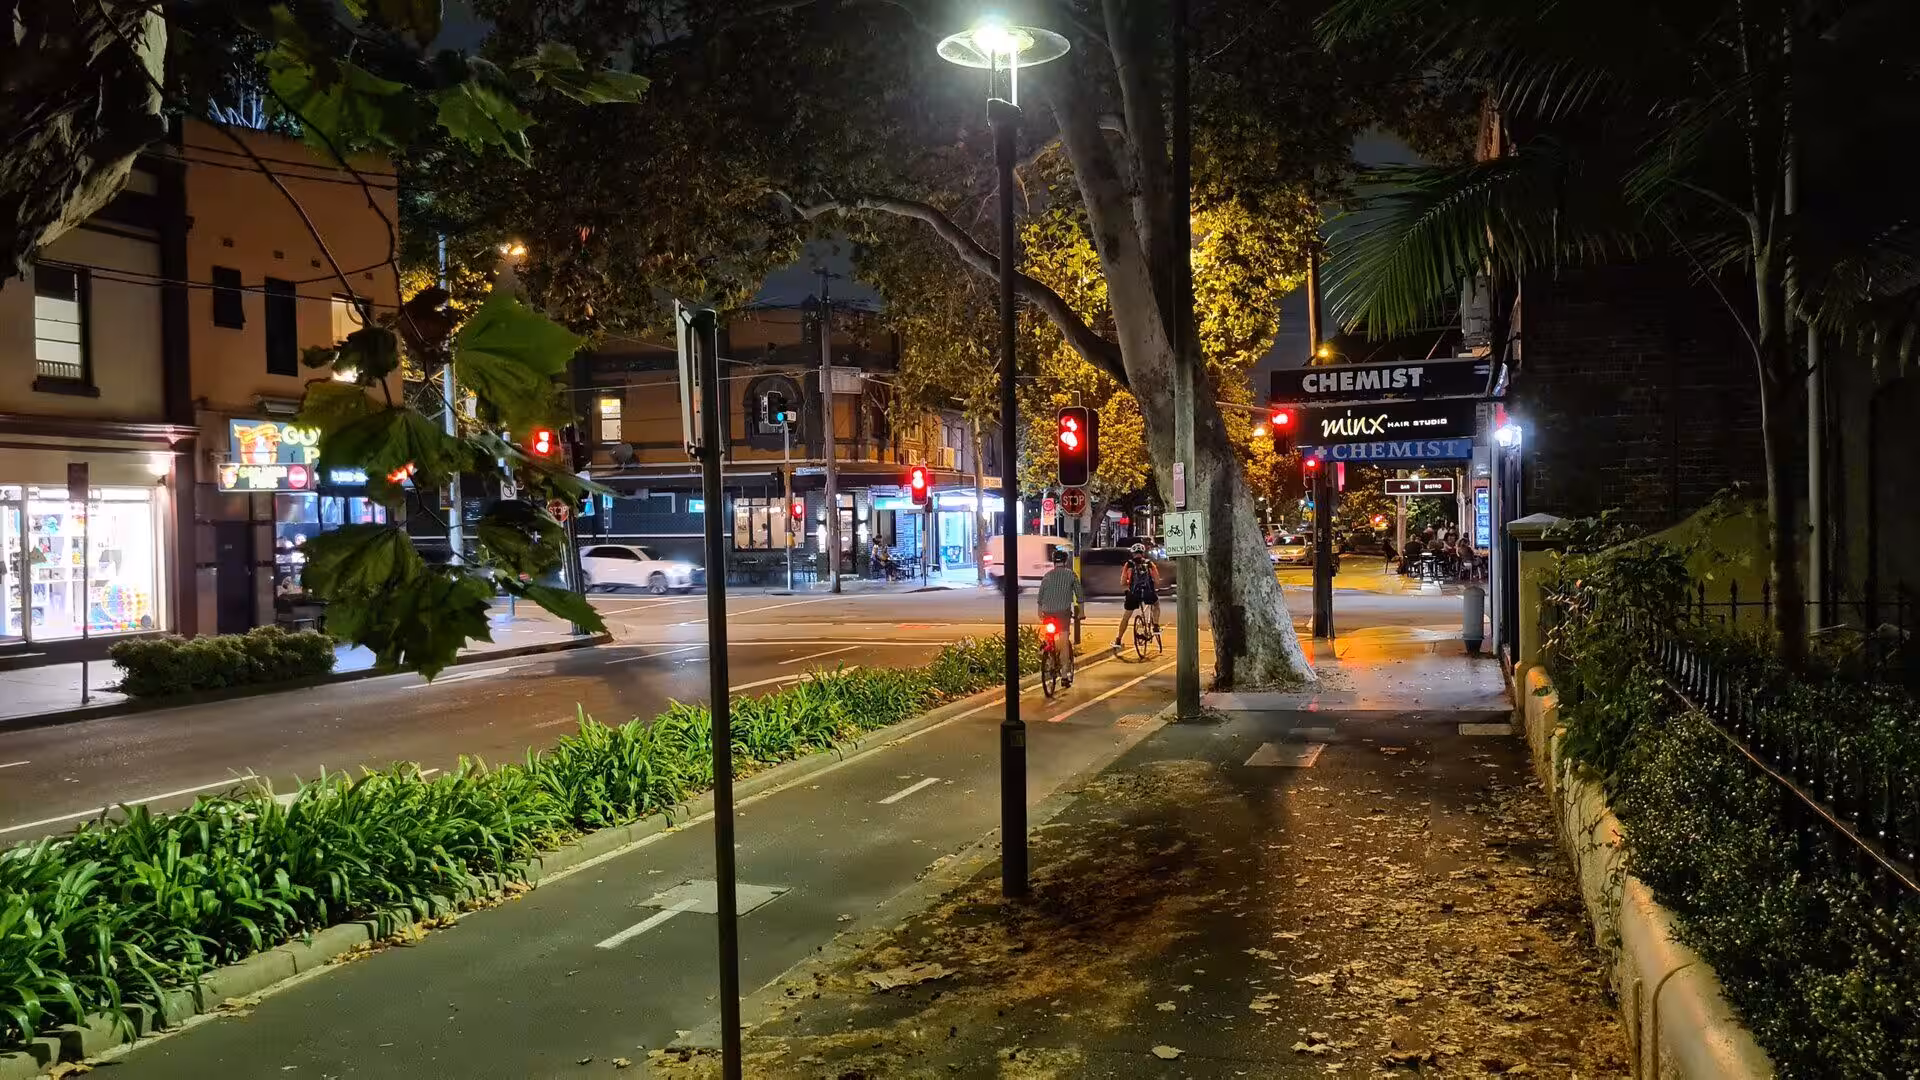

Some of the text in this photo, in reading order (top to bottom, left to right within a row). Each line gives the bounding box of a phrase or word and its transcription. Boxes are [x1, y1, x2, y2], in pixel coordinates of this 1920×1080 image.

[1302, 367, 1423, 393] CHEMIST
[1321, 409, 1387, 438] minx
[1413, 418, 1447, 426] STUDIO
[1332, 440, 1459, 459] CHEMIST
[1062, 495, 1084, 506] STOP
